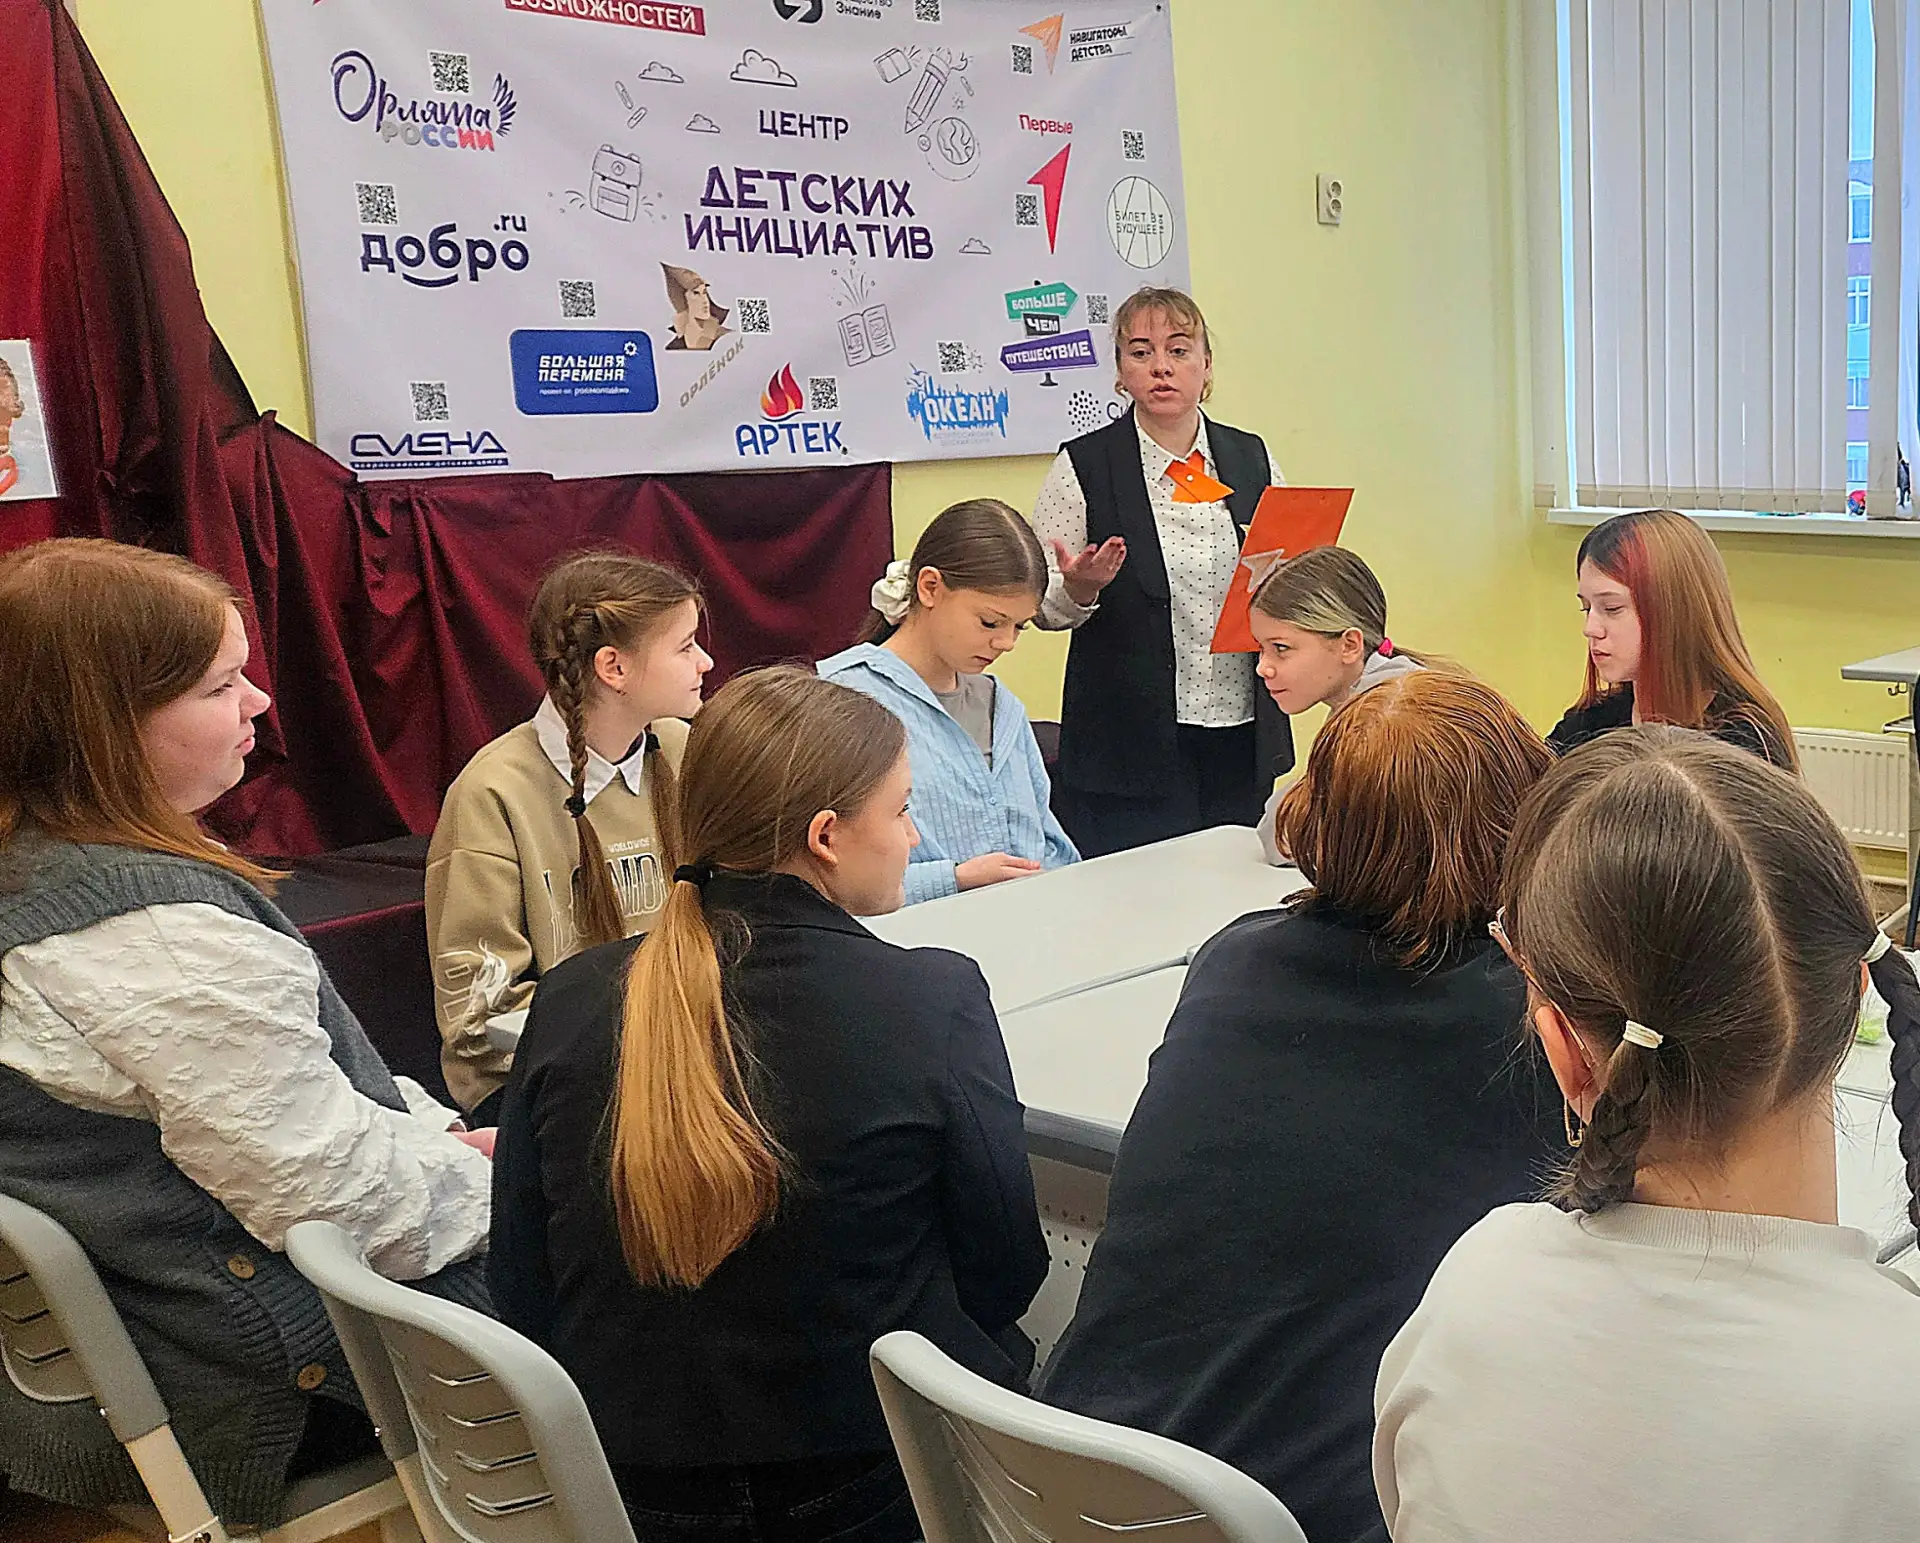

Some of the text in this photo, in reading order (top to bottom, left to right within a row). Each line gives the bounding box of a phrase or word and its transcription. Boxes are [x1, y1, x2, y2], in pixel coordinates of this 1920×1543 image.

[510, 0, 697, 30] ЗМОЖНОСТЕЙ
[836, 1, 881, 19] Знание
[1069, 25, 1128, 44] НАВИГАТОРЫ
[1071, 43, 1113, 62] ДЕТСТВА
[331, 50, 492, 133] Орлята
[380, 121, 495, 152] РОССИИ
[759, 109, 849, 140] ЦЕНТР
[1019, 114, 1073, 137] Первые
[700, 166, 915, 217] ДЕТСКИХ
[494, 214, 527, 232] .ru
[684, 213, 934, 260] ИНИЦИАТИВ
[360, 223, 529, 282] добро
[1011, 292, 1068, 310] БОЛЬШЕ
[1026, 318, 1059, 331] ЧЕМ
[539, 355, 625, 368] БОЛЬШАЯ
[1005, 341, 1091, 364] ПУТЕШЕСТВИЕ
[538, 368, 625, 382] ПЕРЕМЕНА
[680, 336, 744, 408] ОРЛЁНОК
[923, 396, 995, 423] ОКЕАН
[350, 431, 507, 457] СМЕНА
[735, 421, 842, 456] АРТЕК
